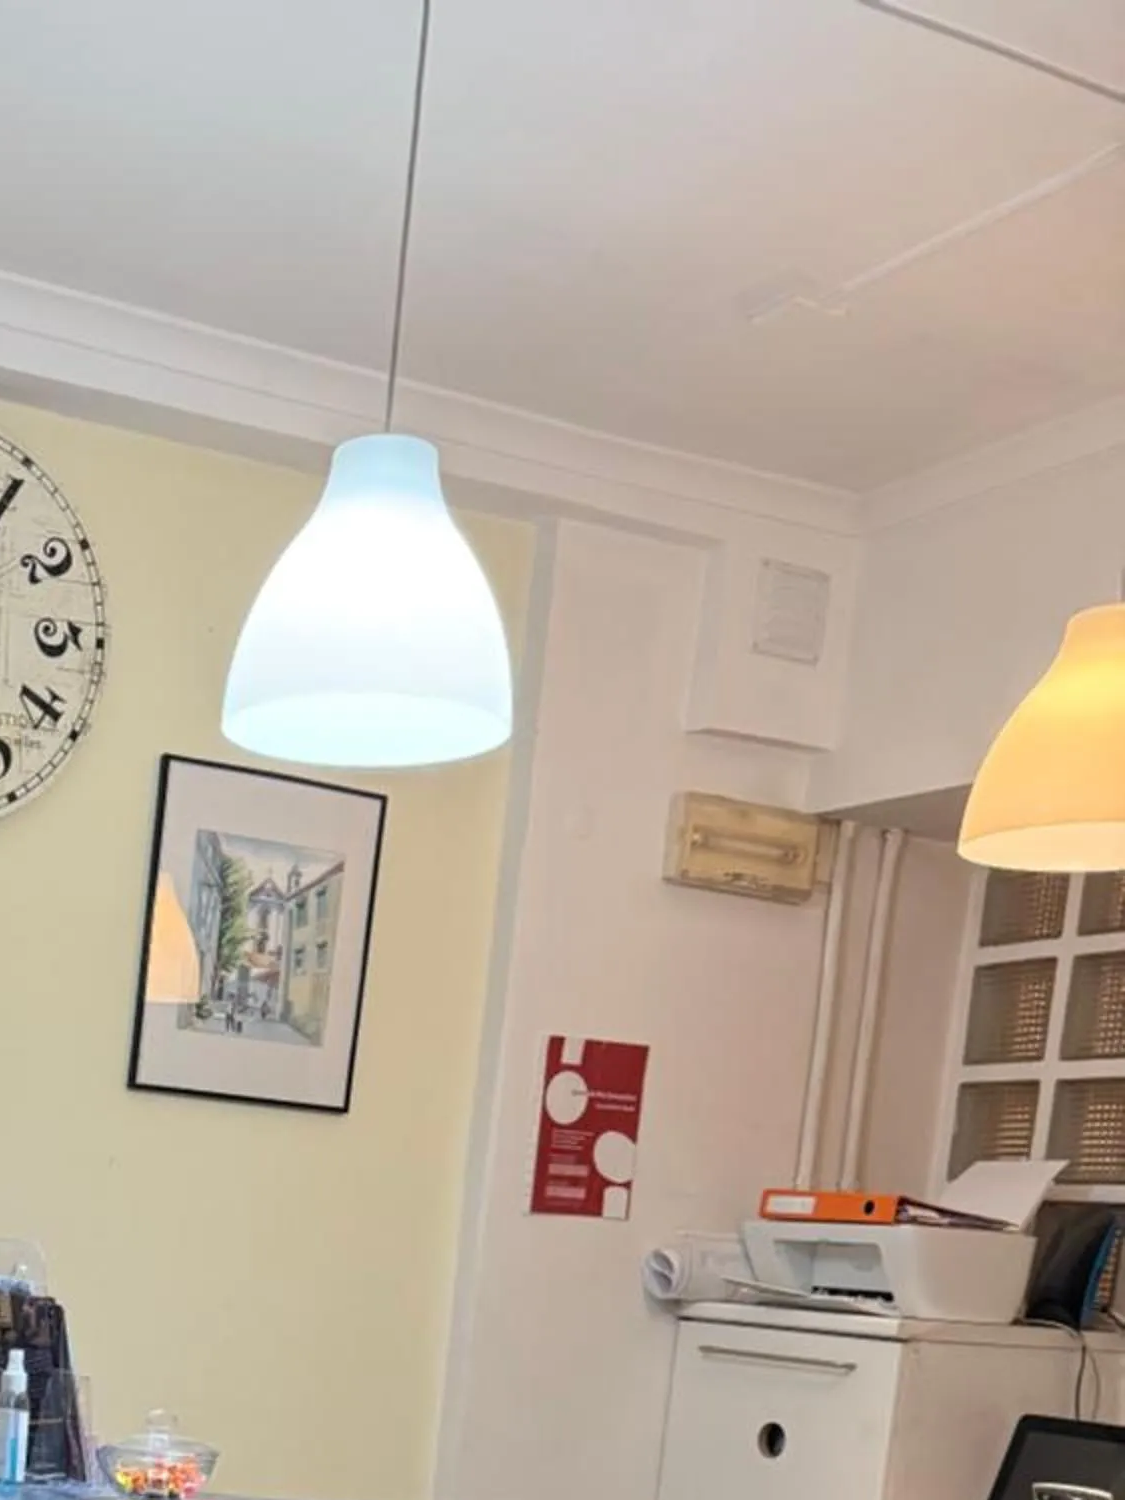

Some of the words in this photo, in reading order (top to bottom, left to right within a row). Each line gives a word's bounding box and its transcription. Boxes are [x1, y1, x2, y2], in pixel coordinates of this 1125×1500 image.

[21, 537, 73, 585] 2
[33, 617, 83, 659] 3
[19, 684, 66, 730] 4
